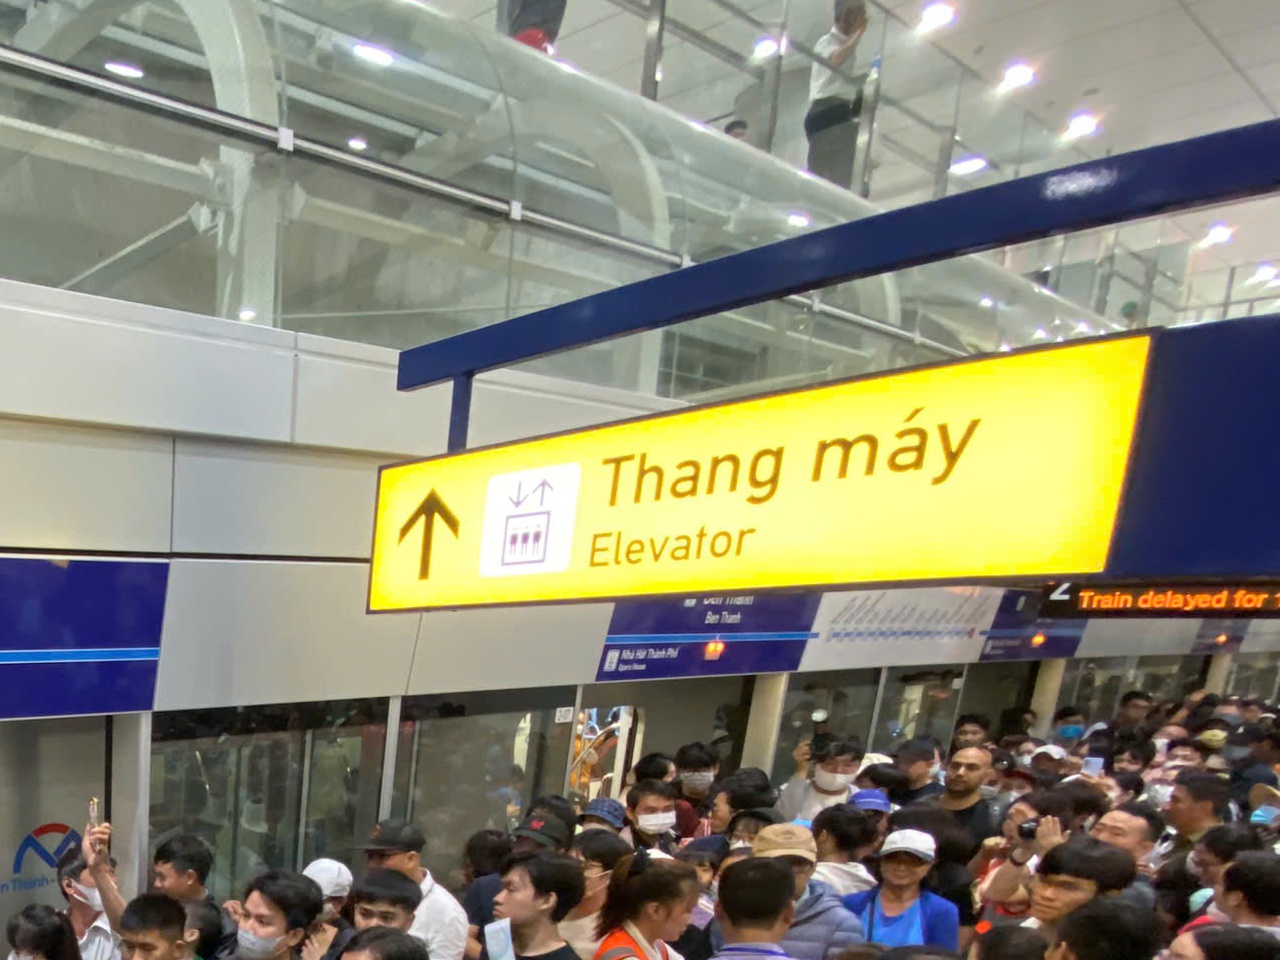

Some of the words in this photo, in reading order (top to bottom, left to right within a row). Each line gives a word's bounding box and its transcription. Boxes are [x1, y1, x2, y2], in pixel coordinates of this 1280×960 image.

[601, 445, 785, 506] Thang
[811, 406, 982, 487] máy
[588, 524, 758, 567] Elevator
[1079, 590, 1132, 608] Train
[1137, 590, 1227, 610] delayed
[1233, 589, 1269, 608] for
